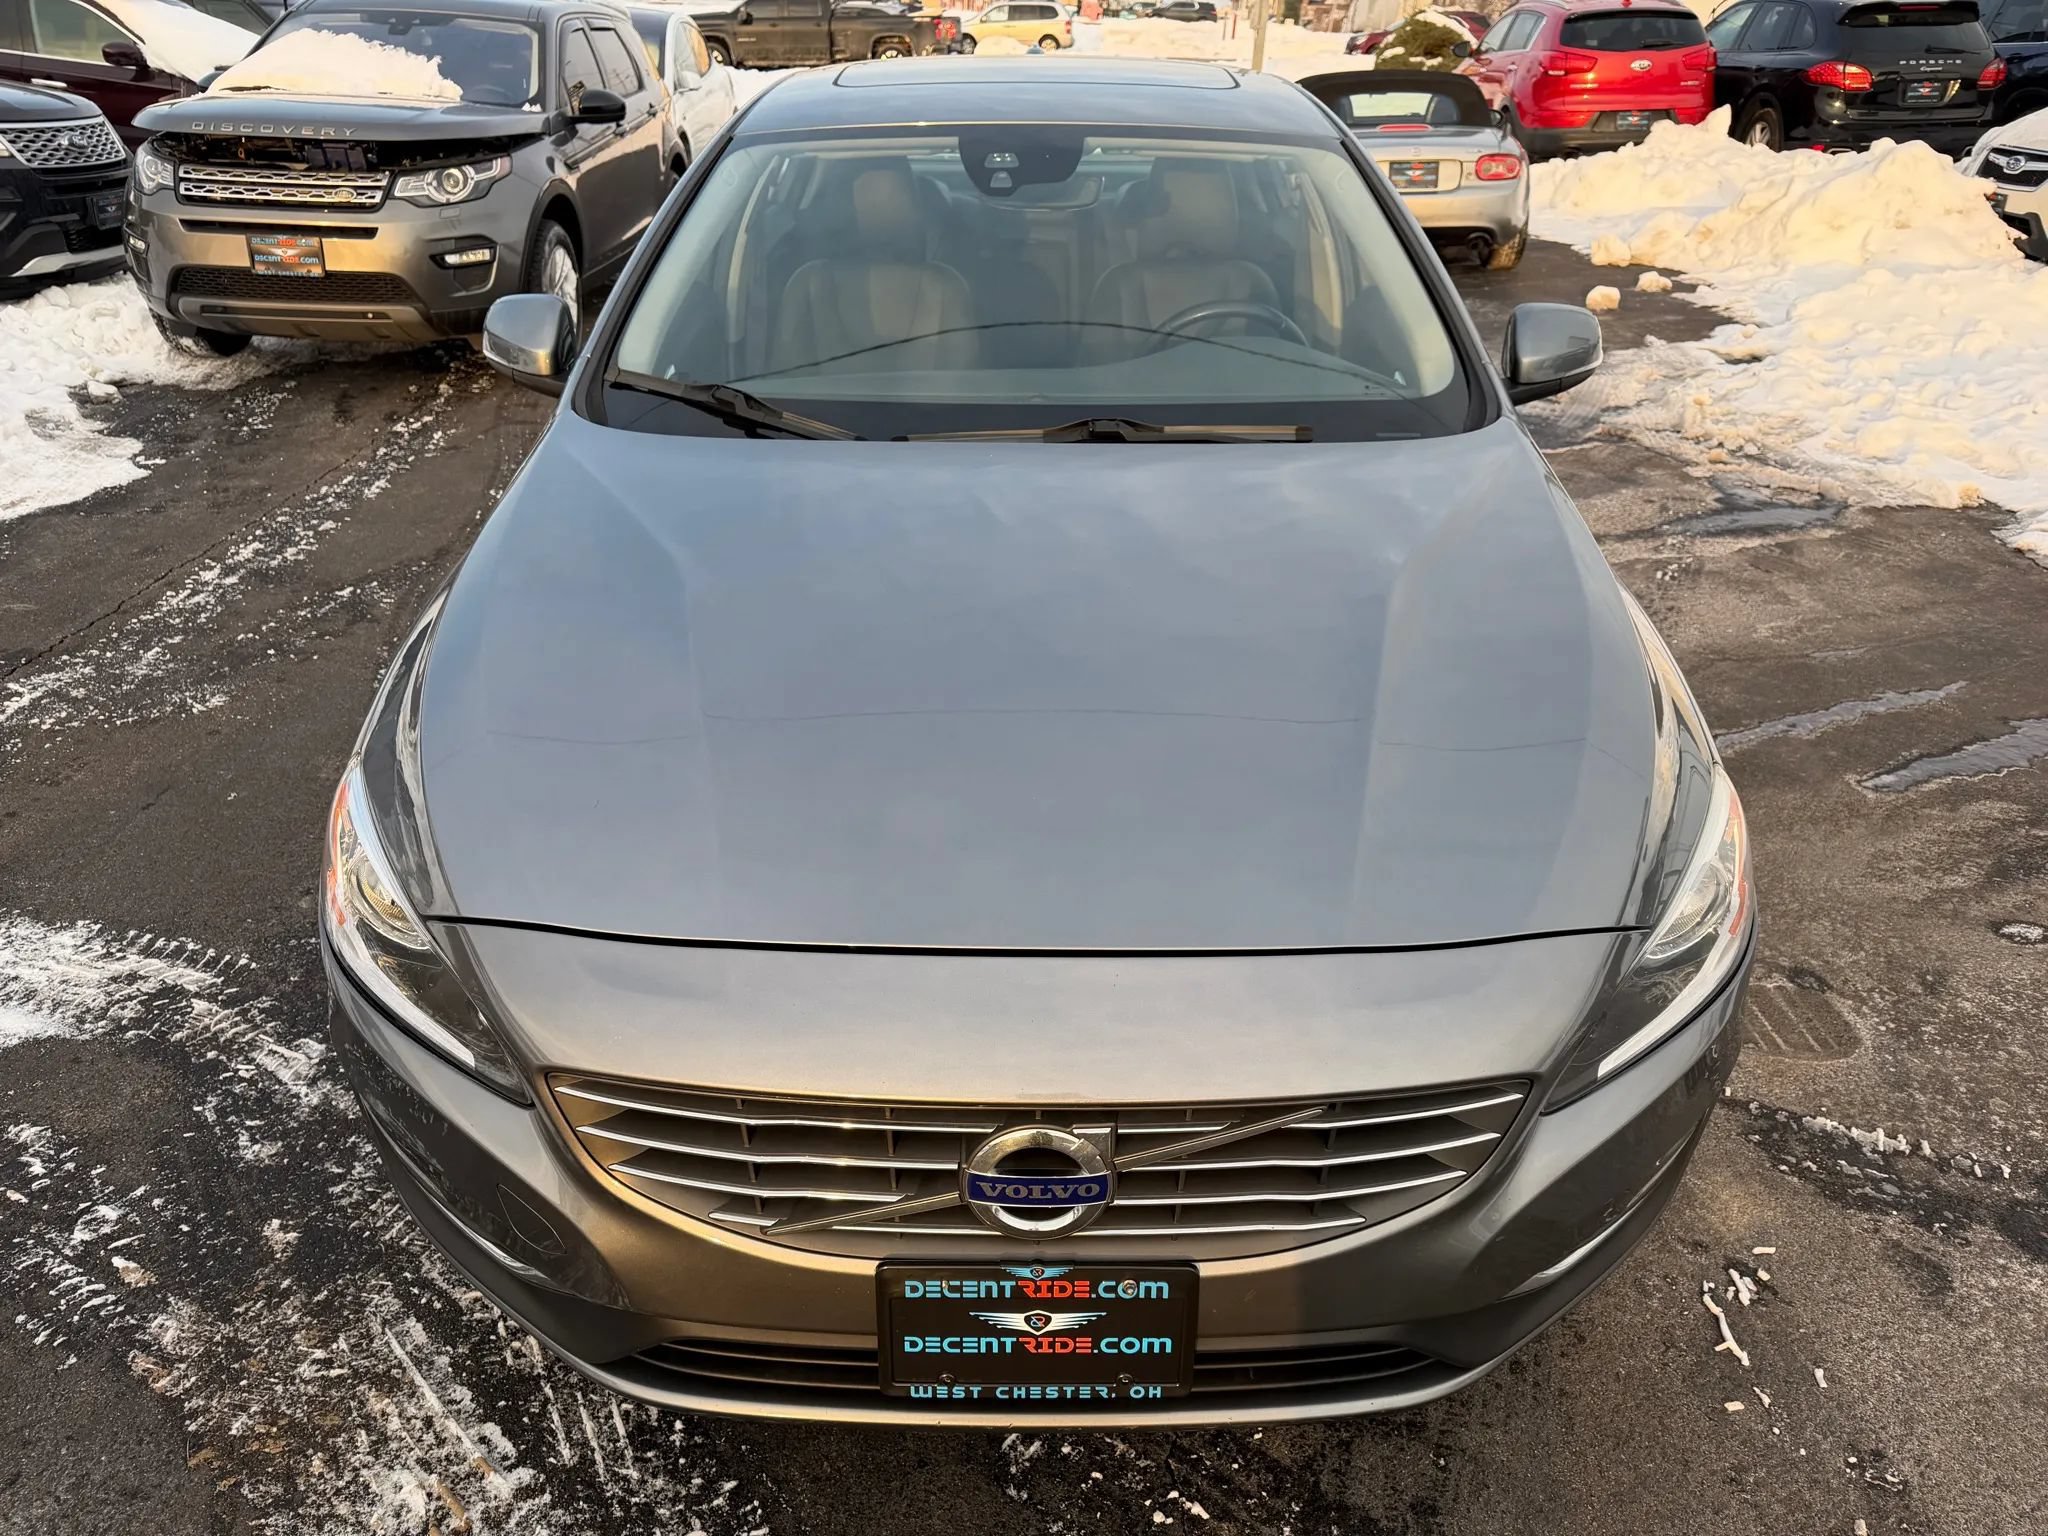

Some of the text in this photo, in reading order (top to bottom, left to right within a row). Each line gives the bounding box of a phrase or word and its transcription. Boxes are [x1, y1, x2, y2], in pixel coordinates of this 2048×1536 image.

[192, 121, 357, 136] DISCOVERY
[976, 1181, 1100, 1200] VOLVO
[910, 1386, 982, 1399] WEST
[1130, 1386, 1162, 1399] OH
